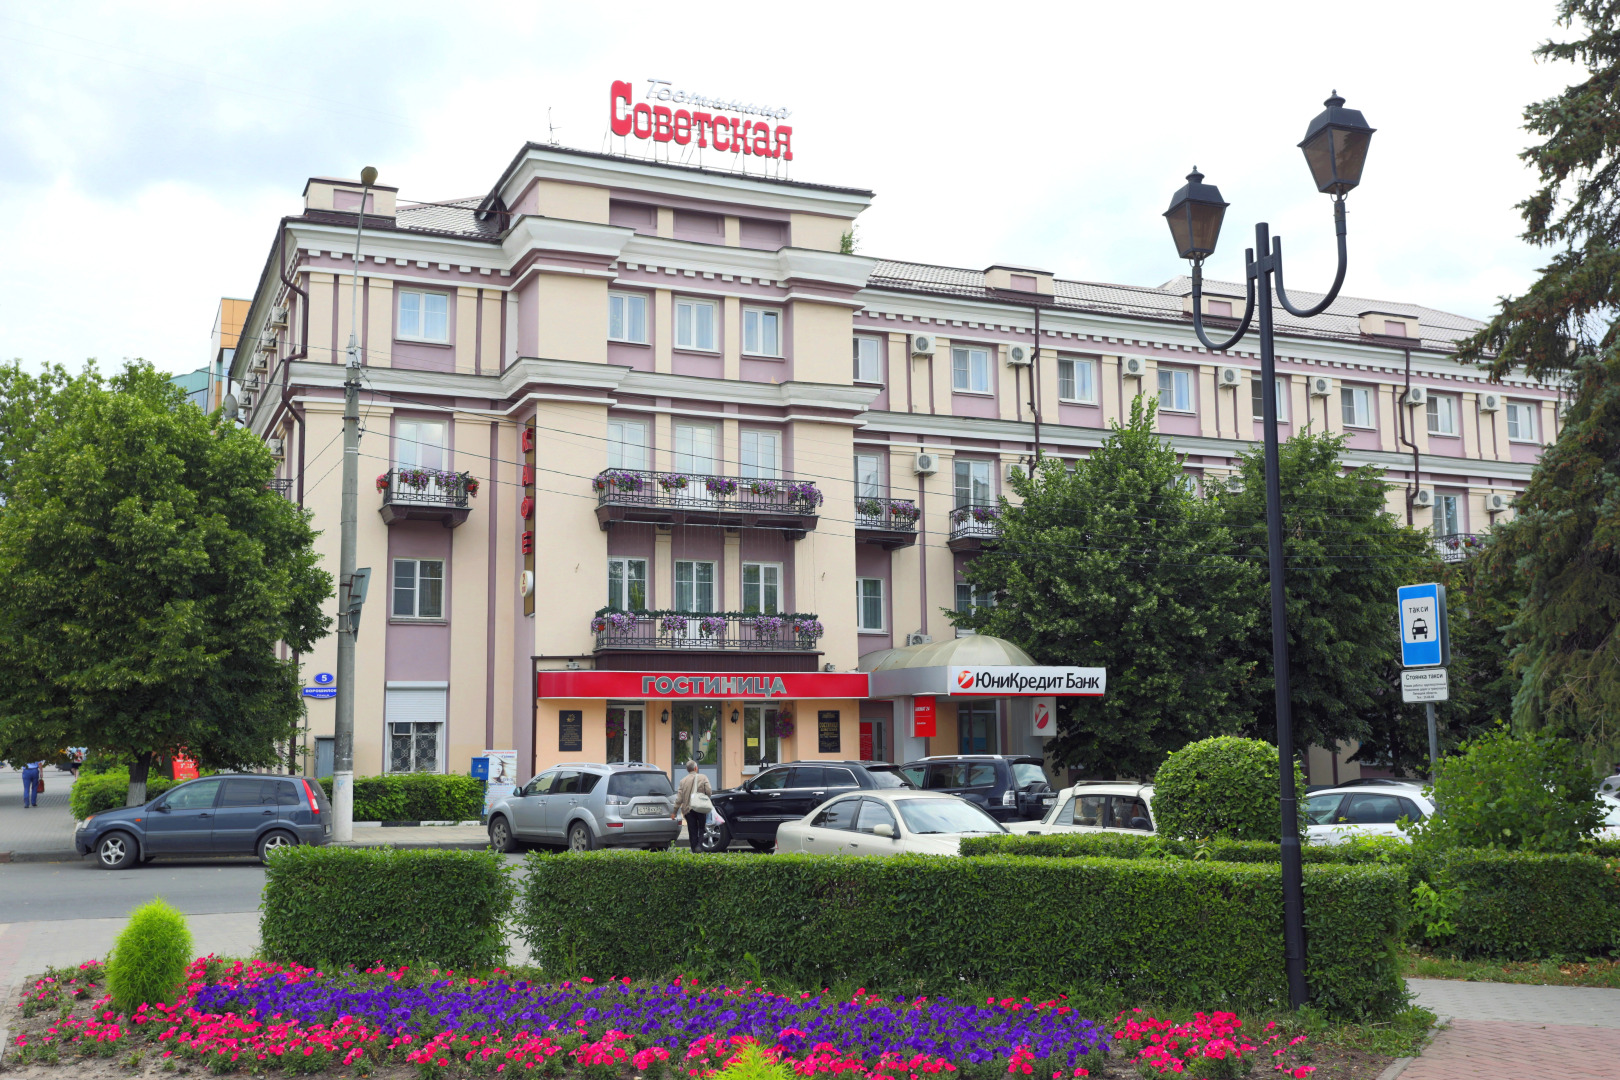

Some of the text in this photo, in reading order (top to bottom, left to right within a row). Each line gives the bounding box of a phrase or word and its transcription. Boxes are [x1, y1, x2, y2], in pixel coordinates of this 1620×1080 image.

[610, 80, 793, 161] Советская
[1409, 606, 1429, 614] такси
[641, 676, 788, 698] ГОСТИНИЦА
[975, 672, 1100, 692] ЮниКредит Банк
